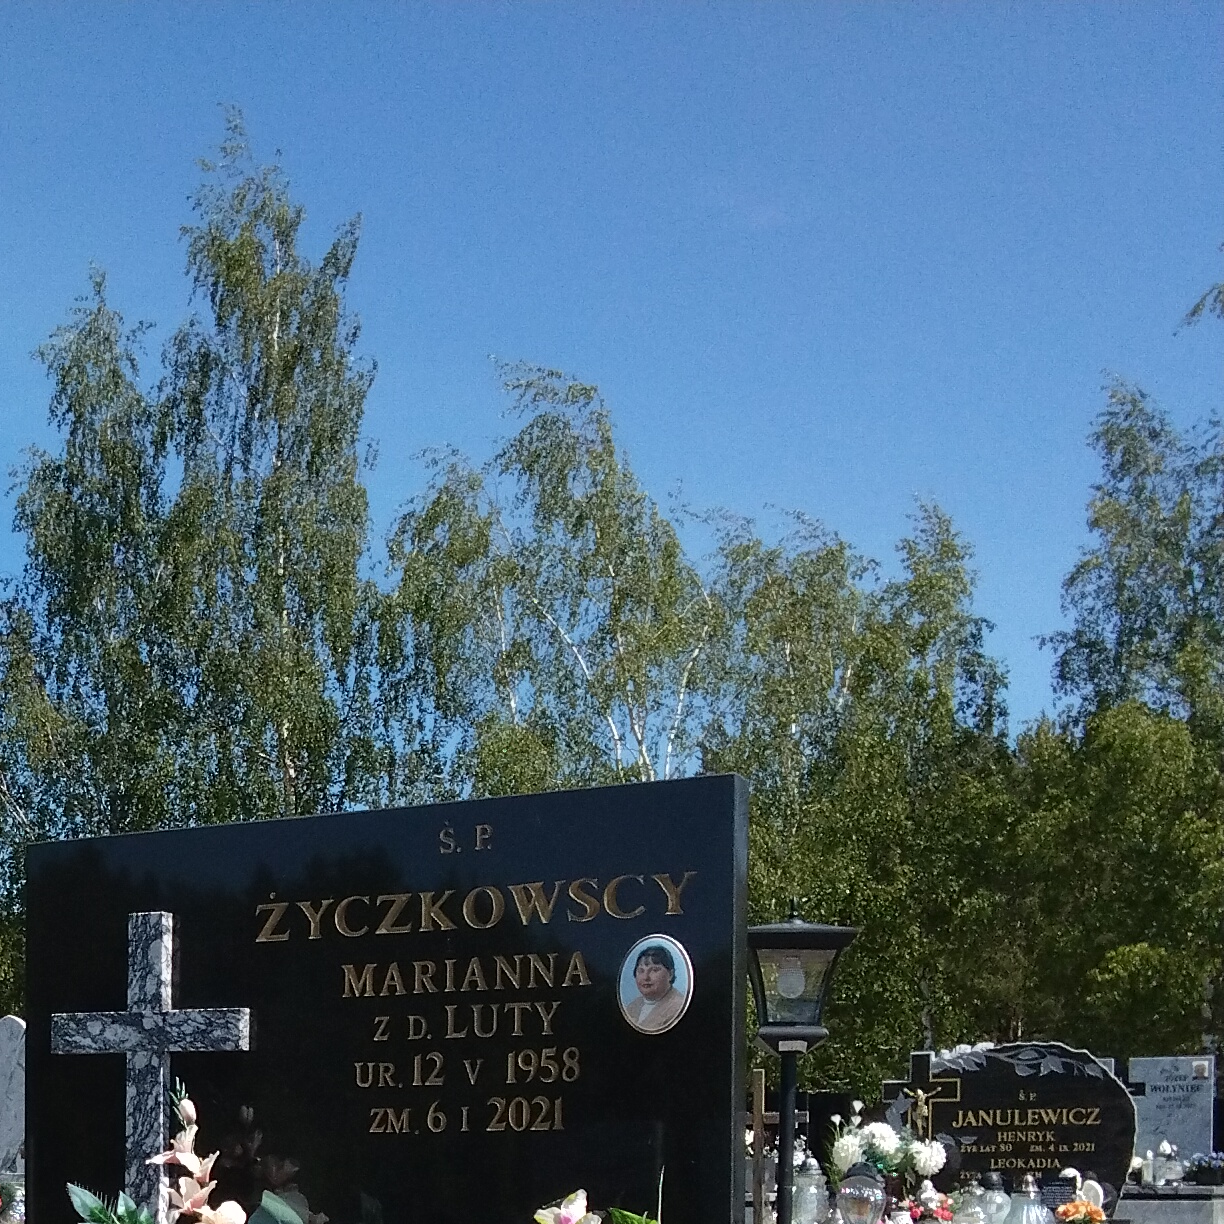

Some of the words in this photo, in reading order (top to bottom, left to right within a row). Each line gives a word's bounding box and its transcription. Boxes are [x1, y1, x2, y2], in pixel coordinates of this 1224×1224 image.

[255, 871, 697, 942] ŻYCZKOWSCY
[341, 951, 592, 998] MARIANNA
[373, 1016, 390, 1041] Z
[407, 1015, 432, 1040] D.
[444, 1001, 562, 1039] LUTY
[354, 1062, 403, 1088] UR.
[412, 1051, 446, 1086] 12
[463, 1059, 483, 1085] V
[505, 1046, 581, 1084] 1958
[369, 1108, 420, 1135] ZM.
[427, 1100, 447, 1133] 6
[460, 1106, 470, 1132] I
[486, 1096, 565, 1132] 2021
[952, 1107, 1102, 1128] JANULEWICZ
[979, 1145, 997, 1153] LAT
[1073, 1142, 1095, 1152] 2021
[997, 1131, 1056, 1142] HENRYK
[990, 1158, 1061, 1169] LEOKADIA
